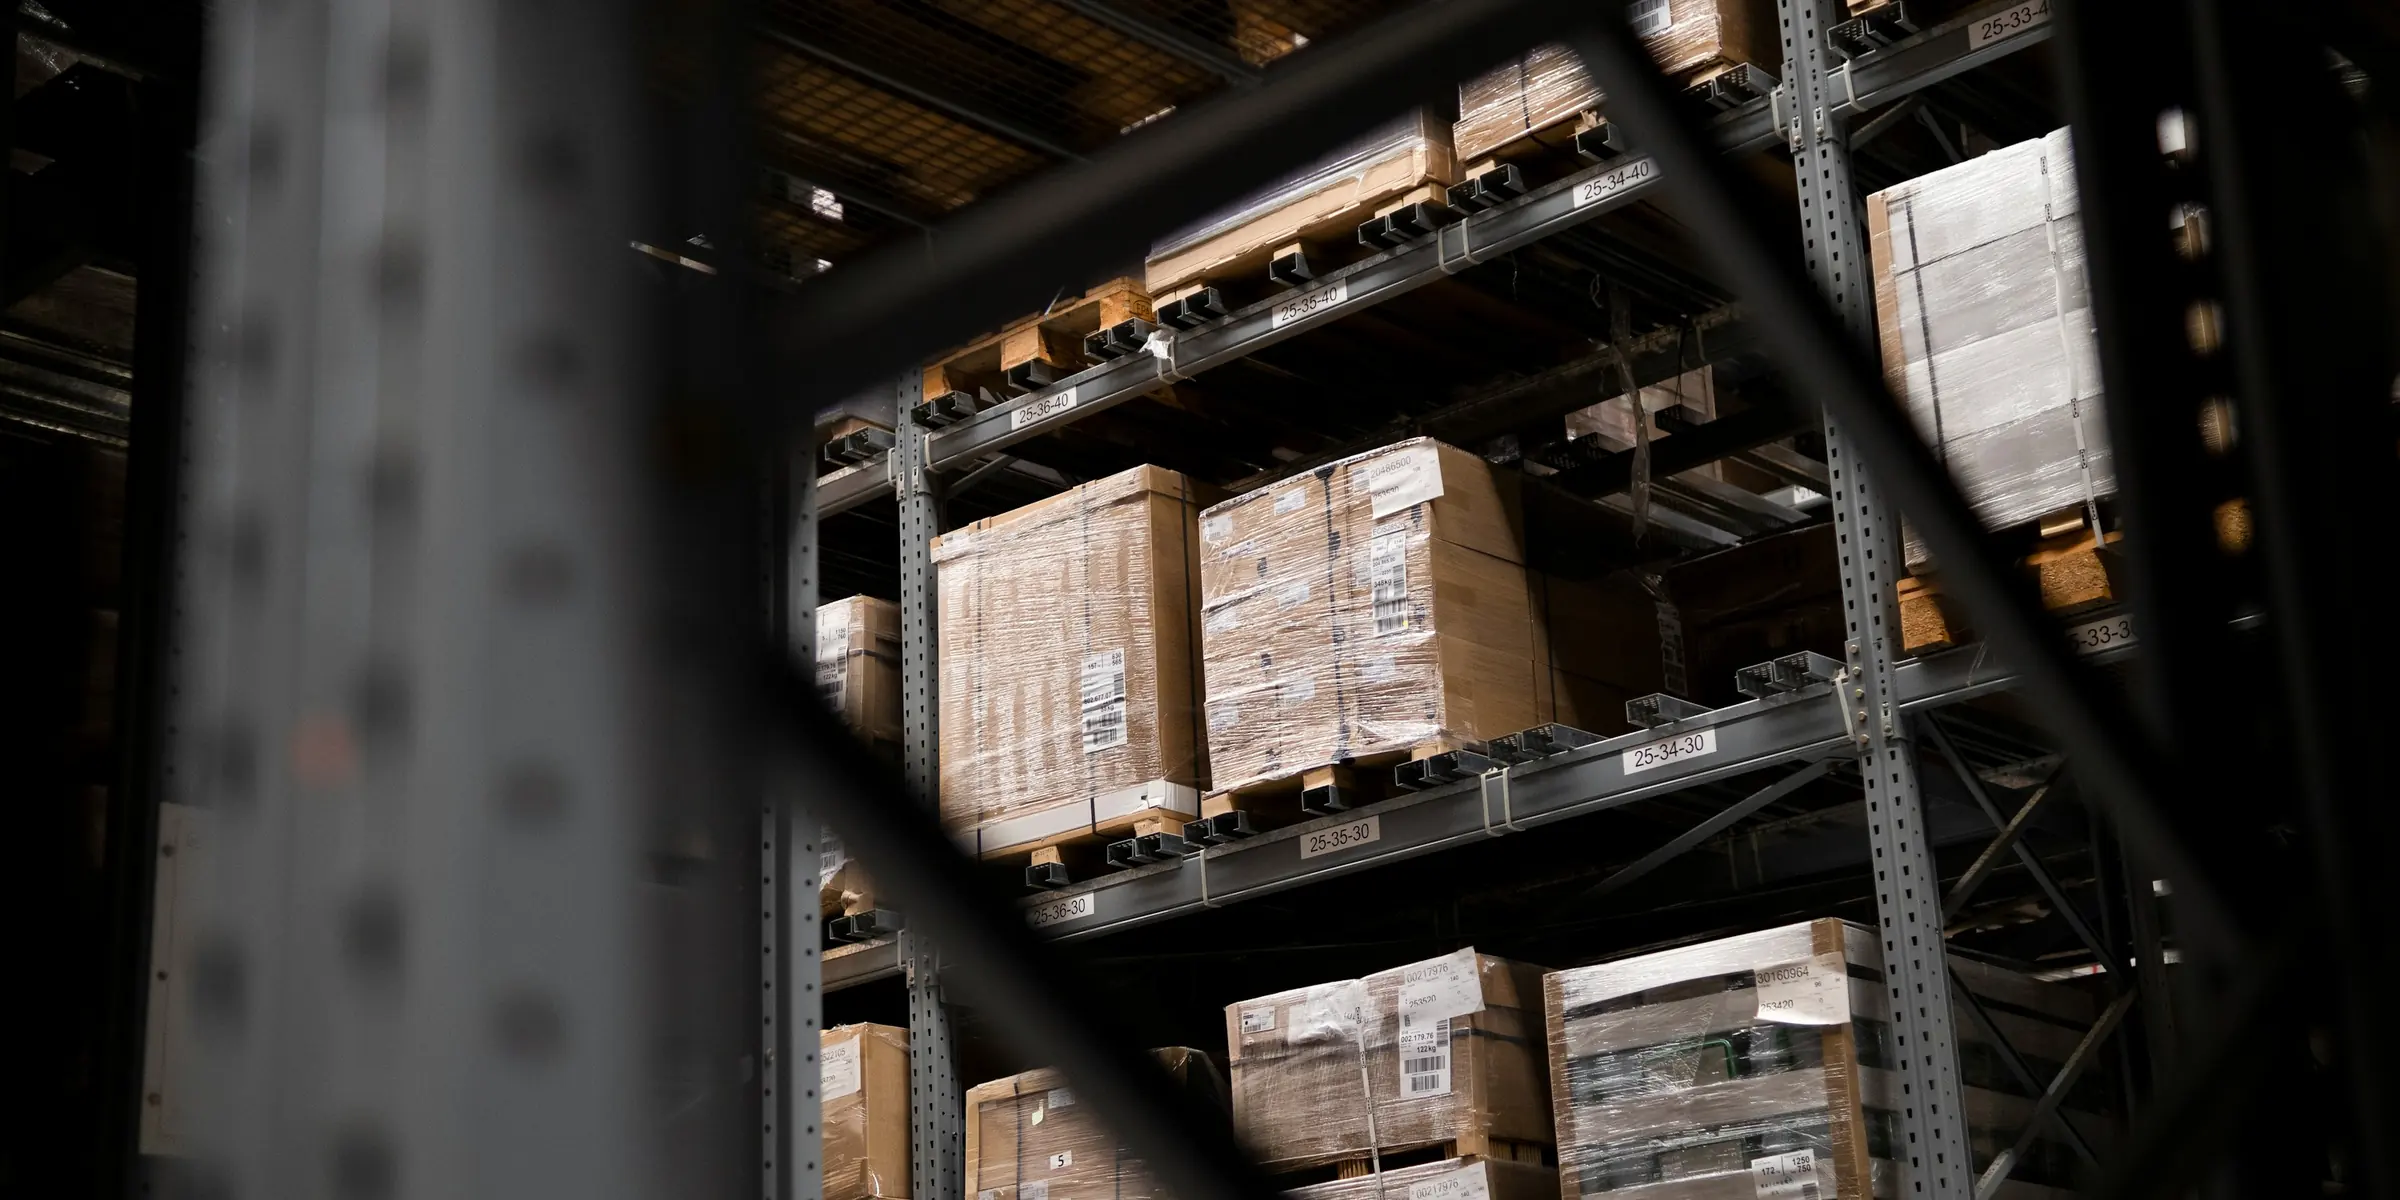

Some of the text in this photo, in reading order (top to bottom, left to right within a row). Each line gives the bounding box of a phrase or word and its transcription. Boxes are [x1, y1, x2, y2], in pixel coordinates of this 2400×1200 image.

[1981, 0, 2053, 40] 25-33-4
[1583, 161, 1649, 200] 25-34-40
[1281, 287, 1338, 322] 25-35-40
[1019, 393, 1069, 424] 25-36-40
[1370, 456, 1412, 479] 20486500
[1634, 734, 1704, 768] 25-34-30
[1310, 823, 1370, 853] 25-35-30
[1034, 898, 1086, 925] 25-36-30
[1406, 962, 1449, 984] 00217976
[1757, 966, 1809, 984] 30160964
[1761, 1000, 1793, 1012] 253420
[1401, 1032, 1434, 1043] 002.179.76
[1416, 1045, 1437, 1054] 122kg
[1058, 1155, 1065, 1168] 5
[1762, 1167, 1775, 1175] 172
[1792, 1156, 1810, 1165] 1250
[1797, 1164, 1811, 1172] 750
[1417, 1178, 1459, 1199] 00217976
